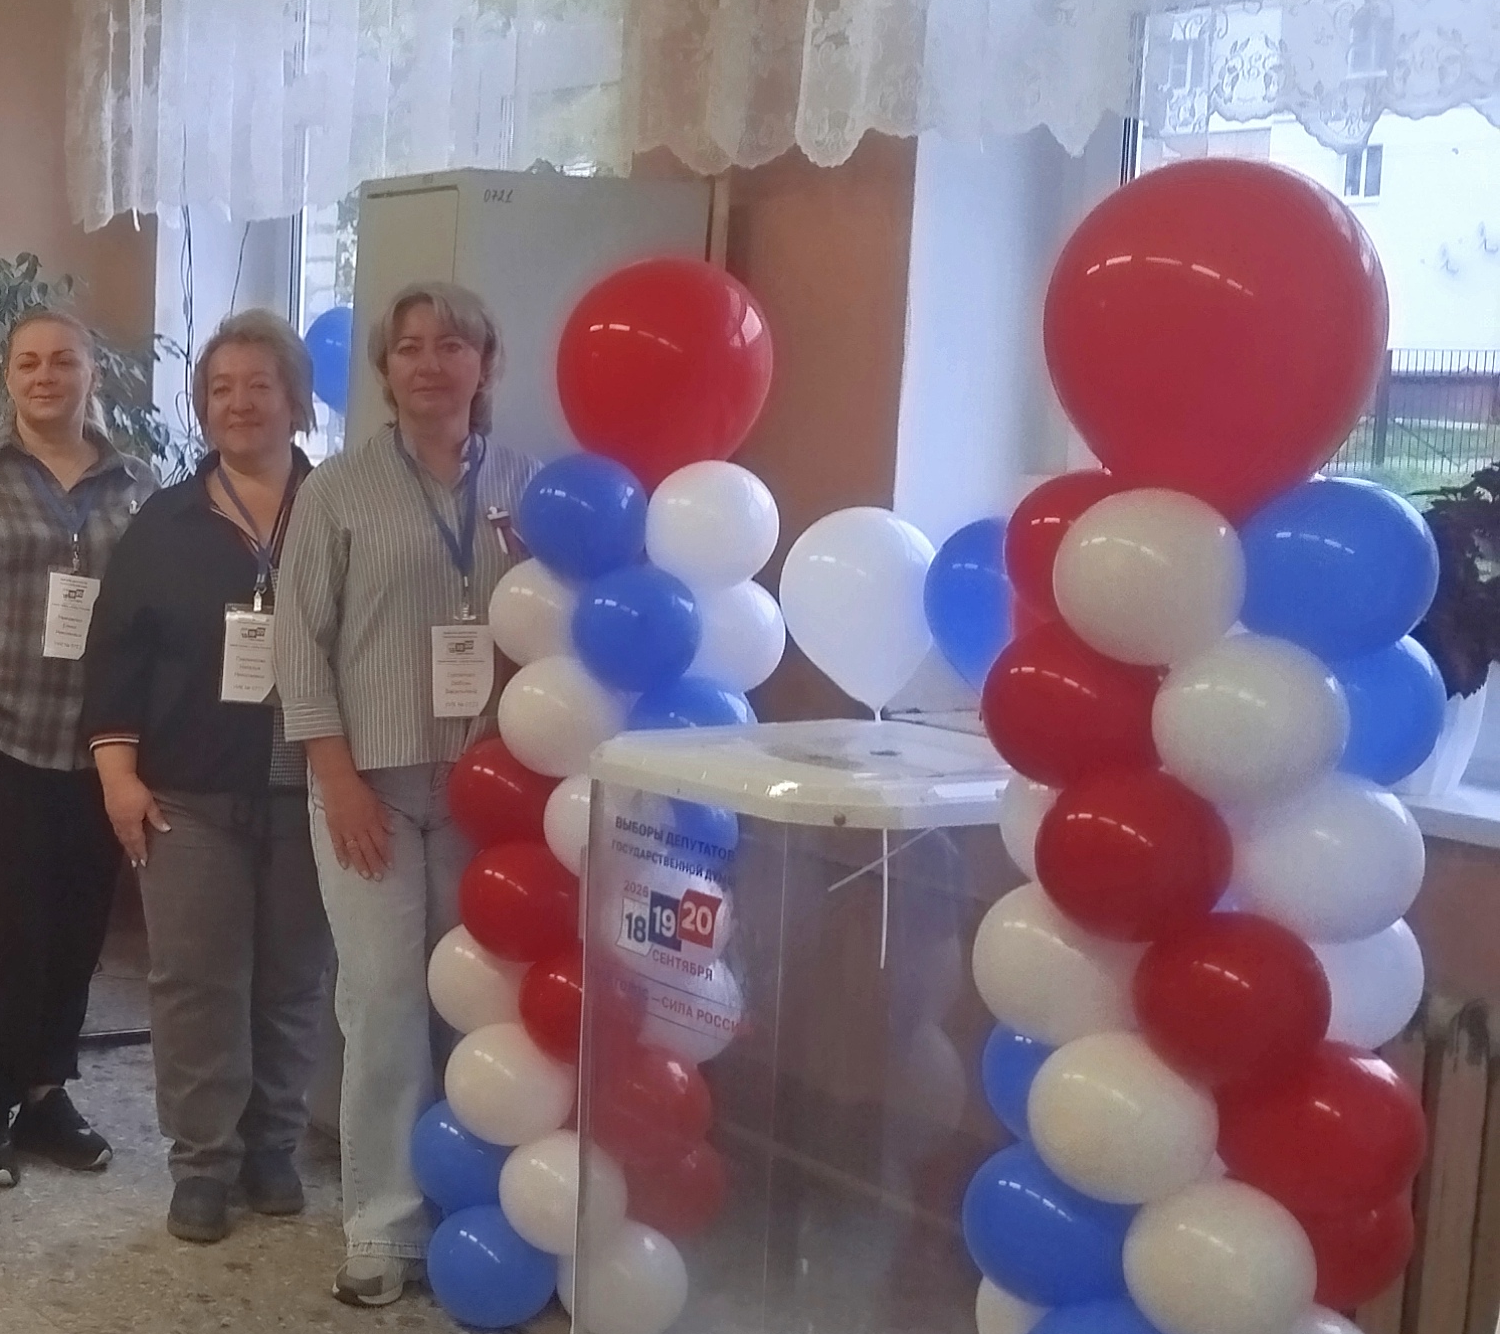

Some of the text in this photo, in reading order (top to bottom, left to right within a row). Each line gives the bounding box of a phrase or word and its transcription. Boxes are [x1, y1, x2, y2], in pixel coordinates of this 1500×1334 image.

[615, 816, 664, 843] ВЫБОРЫ
[612, 839, 703, 877] ГОСУДАРСТВЕННОЙ
[623, 880, 650, 898] 2026
[625, 911, 647, 944] 18
[652, 905, 677, 938] 19
[682, 900, 713, 936] 20
[652, 948, 713, 982] СЕНТЯБРЯ
[661, 996, 694, 1018] СИЛА
